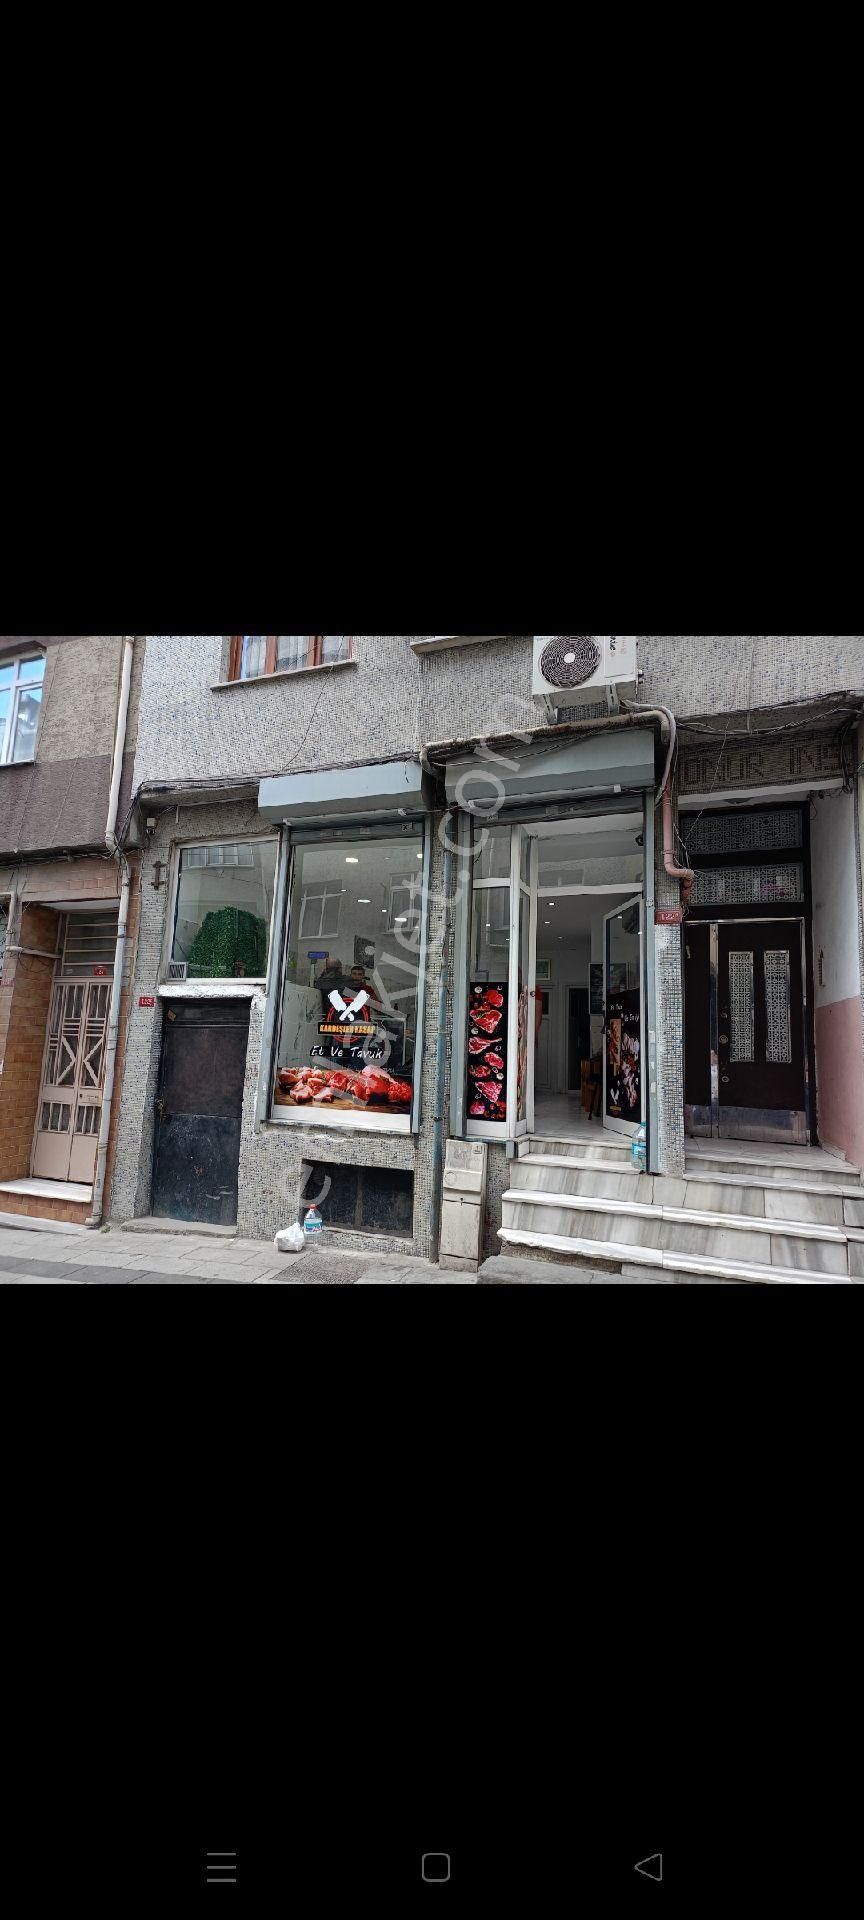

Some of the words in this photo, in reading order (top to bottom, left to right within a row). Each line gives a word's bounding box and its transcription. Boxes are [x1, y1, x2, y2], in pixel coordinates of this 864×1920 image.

[311, 1045, 324, 1056] Et
[331, 1046, 344, 1057] Ve
[349, 1047, 384, 1059] Tavuk
